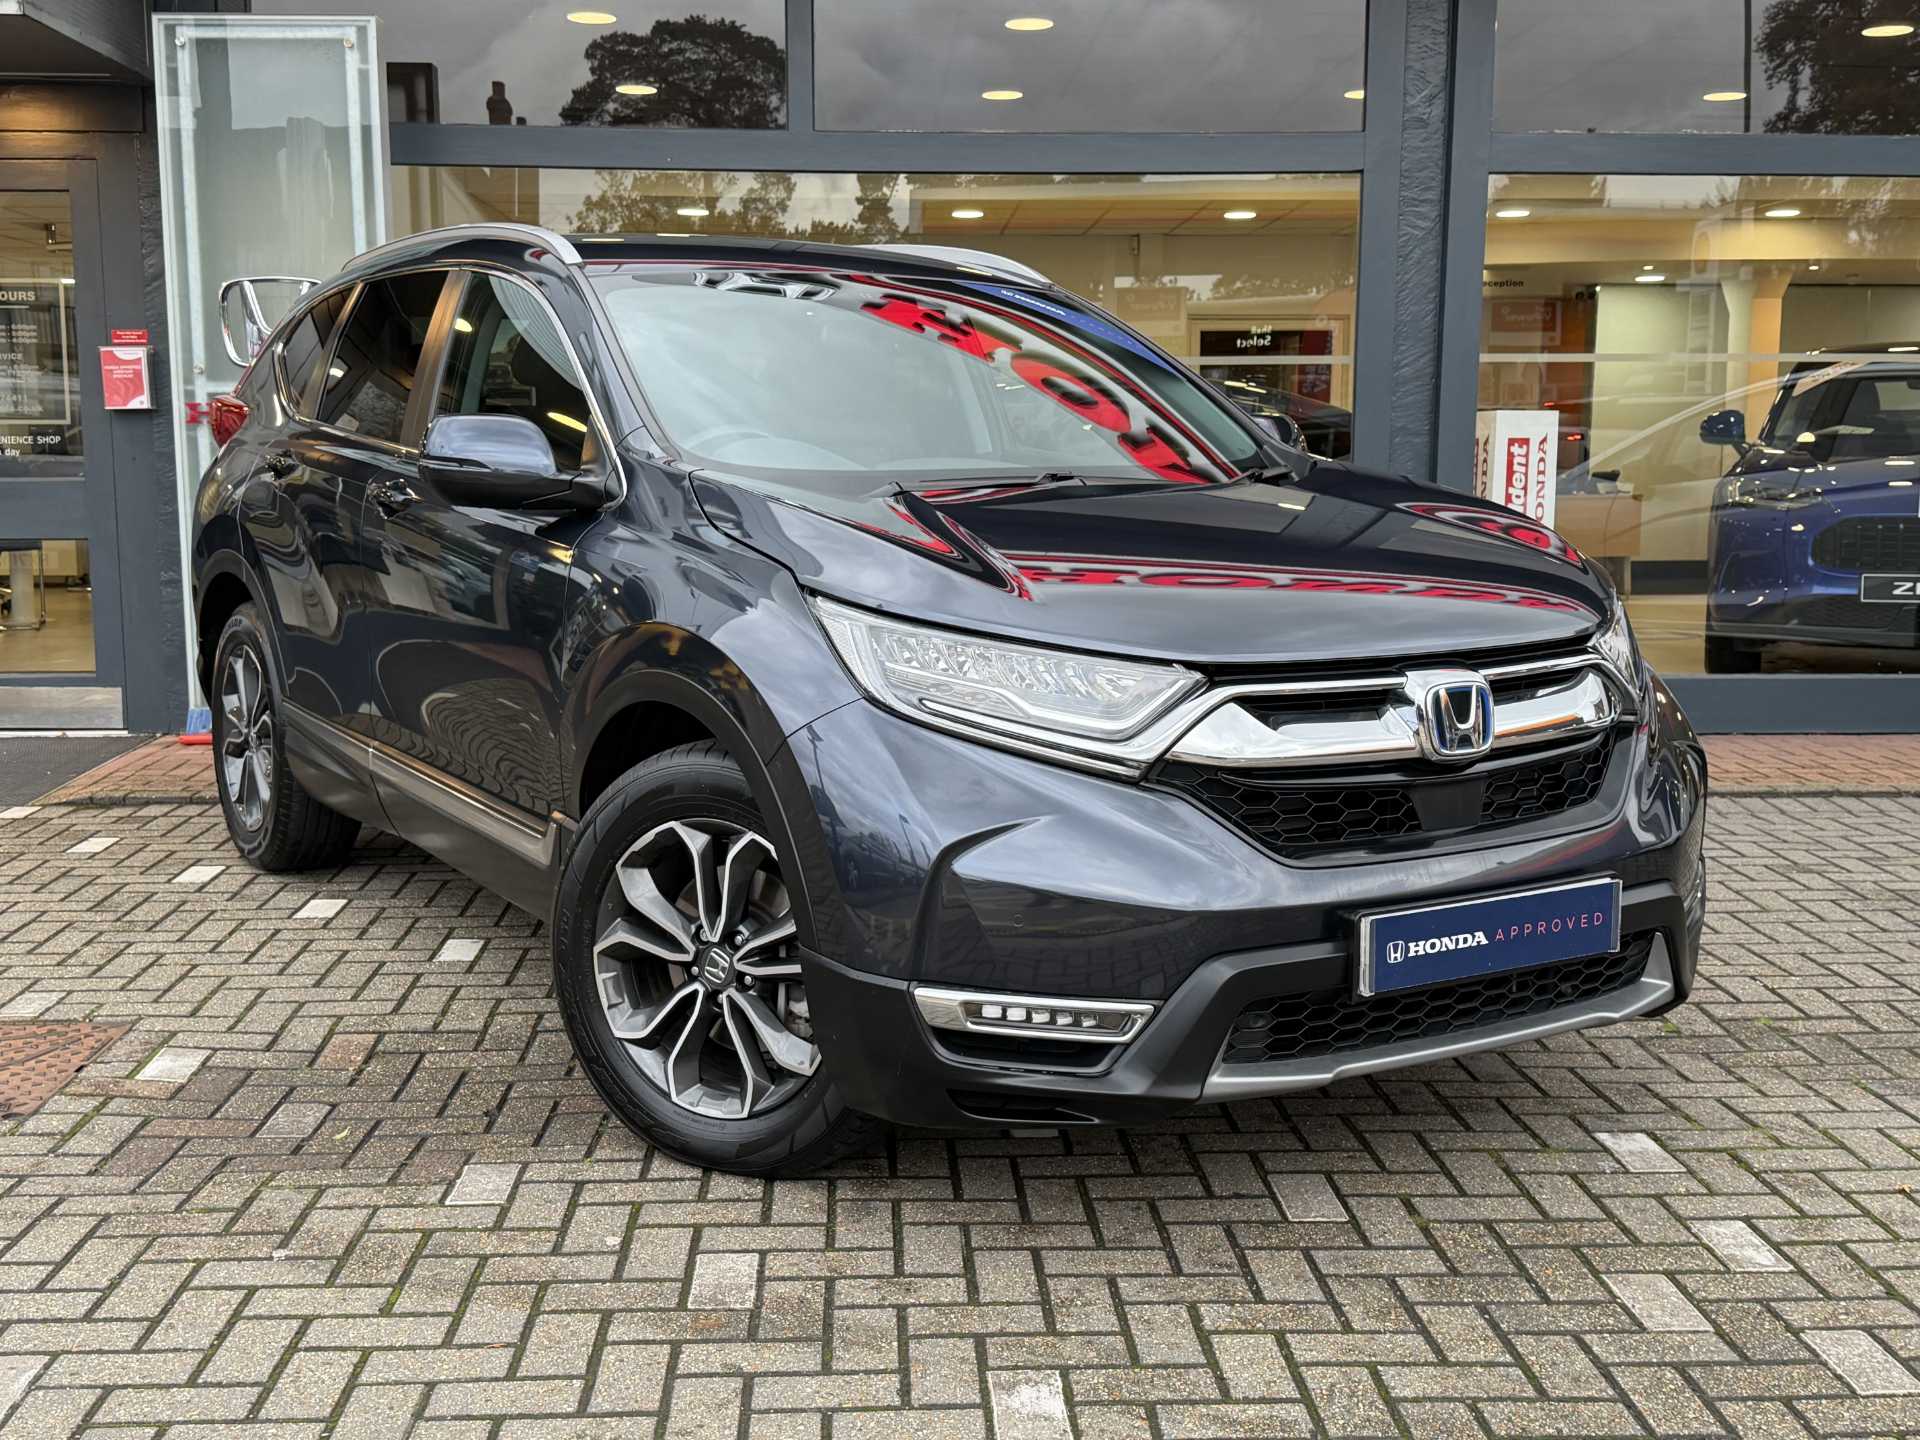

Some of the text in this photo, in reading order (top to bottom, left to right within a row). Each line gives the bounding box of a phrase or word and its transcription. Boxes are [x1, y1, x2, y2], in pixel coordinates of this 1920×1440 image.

[37, 435, 61, 445] SHOP
[5, 448, 21, 457] day
[1407, 931, 1489, 957] HONDA
[1495, 912, 1603, 942] APPROVED
